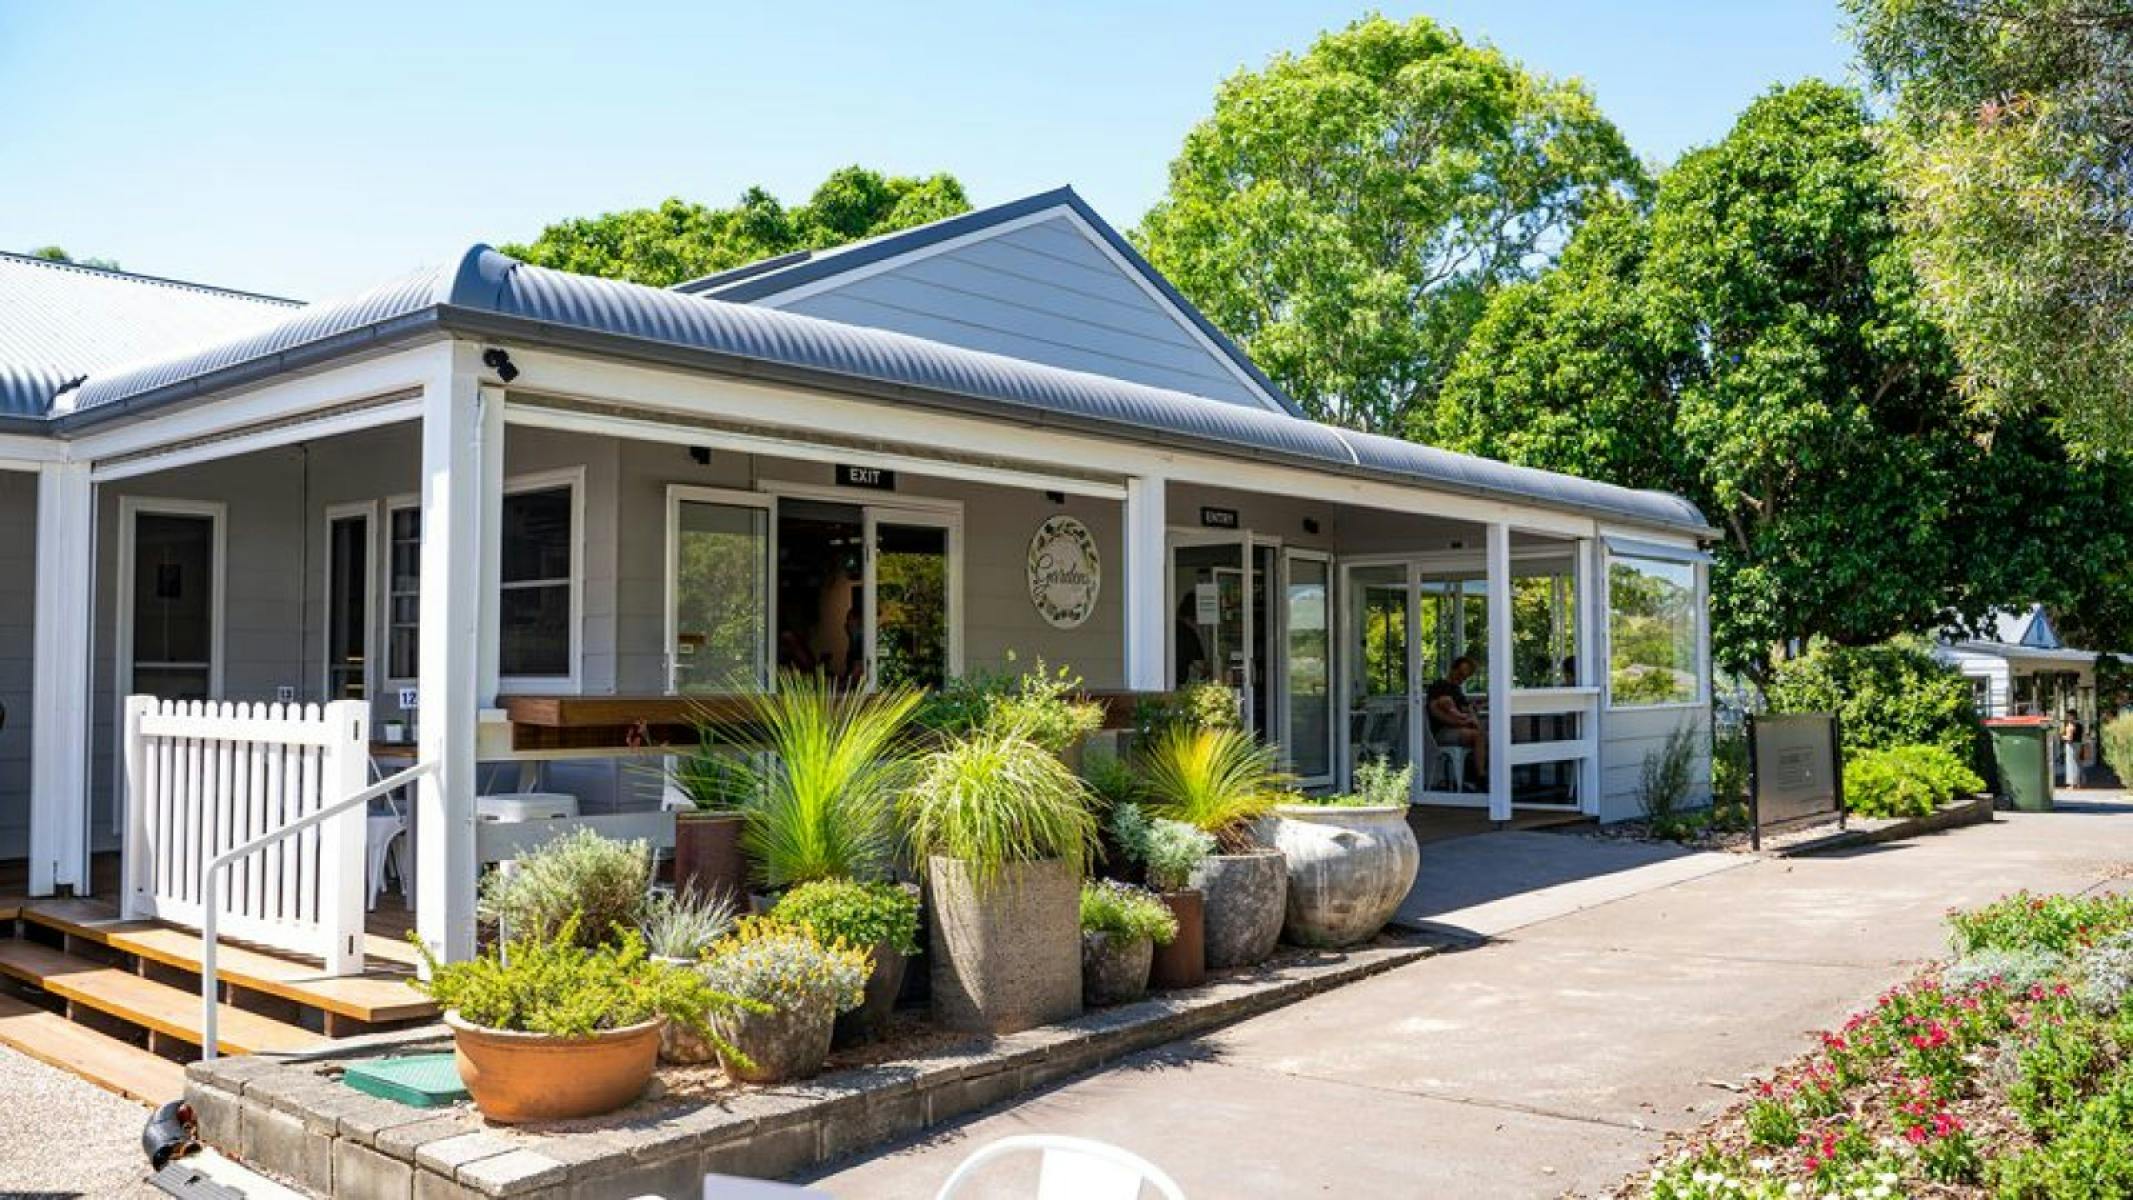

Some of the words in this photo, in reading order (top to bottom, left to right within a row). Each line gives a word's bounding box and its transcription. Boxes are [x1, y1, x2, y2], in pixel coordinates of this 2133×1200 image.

[850, 468, 881, 485] EXIT
[1205, 511, 1234, 525] ENTRY
[402, 692, 417, 704] 12
